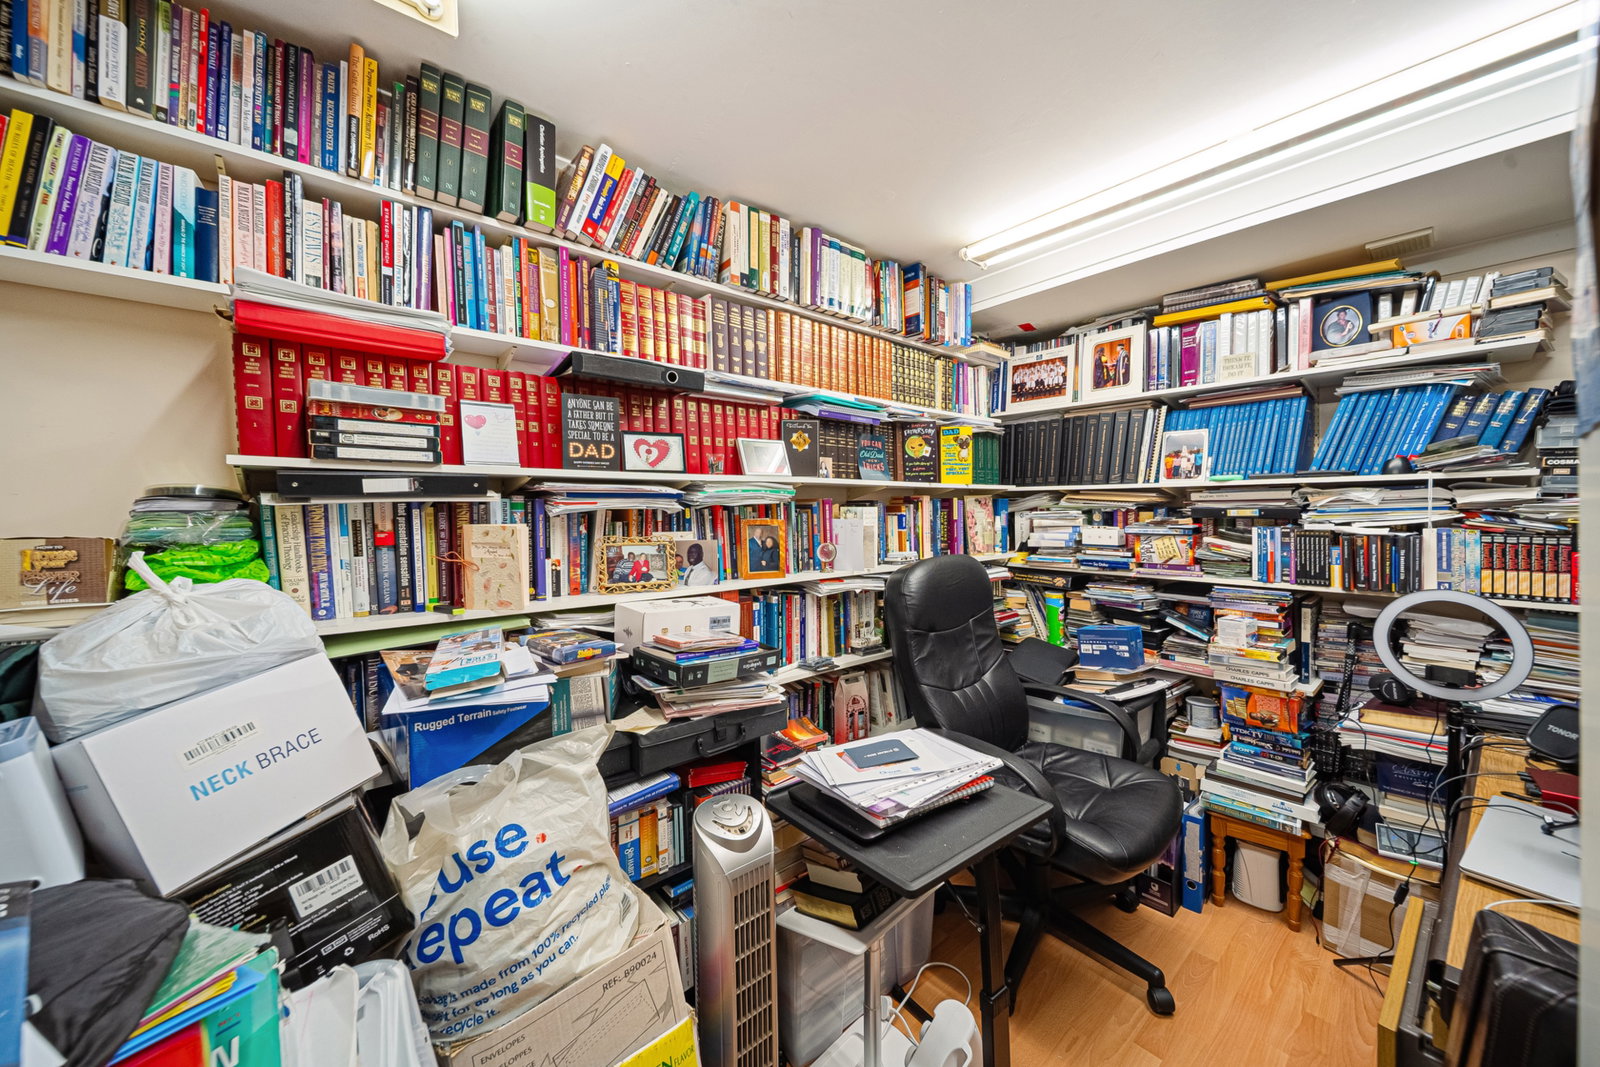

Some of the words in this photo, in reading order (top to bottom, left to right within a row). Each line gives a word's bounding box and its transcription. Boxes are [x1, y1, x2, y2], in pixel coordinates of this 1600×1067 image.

[138, 18, 147, 48] BOOK
[254, 36, 264, 56] PRAISE
[208, 42, 217, 70] KENDALL
[352, 55, 360, 69] The
[110, 60, 120, 84] TRUST
[254, 57, 264, 86] RELEASES
[366, 68, 374, 86] Purpose
[327, 70, 335, 94] PRAYER
[254, 87, 262, 105] FAITH
[351, 88, 359, 114] Church
[326, 100, 335, 128] RICHARD
[14, 121, 24, 132] THE
[366, 112, 374, 140] AUTHORITY
[11, 132, 20, 148] RULES
[35, 131, 43, 142] THE
[326, 128, 334, 151] FOSTER
[10, 149, 18, 158] OF
[32, 143, 41, 158] RULES
[90, 145, 109, 164] MAYA
[4, 159, 15, 180] WEALTH
[30, 160, 38, 168] OF
[118, 154, 136, 175] MAYA
[140, 161, 154, 180] MAYA
[160, 165, 170, 180] MAYA
[27, 169, 36, 184] WORK
[64, 176, 76, 192] Beauty
[84, 164, 104, 196] ANGELOU
[220, 177, 229, 194] MAYA
[114, 176, 134, 206] ANGELOU
[138, 180, 151, 204] ANGELOU
[160, 180, 169, 207] ANGELOU
[238, 186, 250, 203] MAYA
[254, 190, 264, 207] MAYA
[60, 200, 70, 212] Ashes
[220, 194, 230, 218] ANGELOU
[238, 203, 250, 232] ANGELOU
[254, 208, 264, 235] ANGELOU
[304, 230, 322, 264] LEWIS
[567, 398, 592, 409] ANYONE
[592, 400, 606, 410] CAN
[606, 402, 614, 411] BE
[568, 410, 572, 418] A
[573, 410, 594, 420] FATHER
[595, 411, 606, 420] BUT
[608, 412, 614, 420] IT
[567, 419, 586, 430] TAKES
[587, 420, 614, 432] SOMEONE
[567, 430, 592, 440] SPECIAL
[592, 432, 601, 440] TO
[602, 432, 609, 441] BE
[610, 432, 614, 441] A
[860, 439, 872, 448] YOU
[872, 440, 882, 449] CAN
[568, 442, 616, 460] DAD
[860, 450, 872, 458] Old
[872, 450, 884, 458] Dad
[862, 462, 884, 472] TRICKS
[398, 503, 406, 516] that
[264, 522, 273, 537] BARNA
[290, 511, 301, 541] Leadership
[438, 512, 446, 530] LEADERS
[282, 520, 292, 544] Practical
[396, 517, 408, 556] presentation
[294, 542, 304, 574] Handbooks
[310, 538, 328, 572] PREACHING
[439, 540, 448, 557] LOYALTY
[282, 546, 294, 571] Theology
[381, 548, 390, 572] RUDOLPH
[400, 556, 409, 586] sensation
[24, 576, 78, 602] Life
[382, 580, 390, 604] GIULIANI
[1225, 666, 1250, 676] CHARLES
[1252, 670, 1270, 678] CAPPS
[1230, 675, 1255, 684] CHARLES
[1256, 678, 1275, 687] CAPPS
[414, 715, 456, 732] Rugged
[457, 708, 492, 724] Terrain
[1234, 726, 1252, 738] TDK
[1252, 730, 1264, 739] TV
[1548, 724, 1579, 740] TONOR
[1232, 746, 1256, 755] SONY
[188, 758, 254, 802] NECK
[256, 726, 322, 770] BRACE
[624, 847, 634, 858] 8th
[368, 924, 390, 942] RoHS
[460, 976, 497, 998] made
[498, 959, 530, 980] from
[532, 930, 560, 960] 100%
[561, 895, 598, 934] recycled
[451, 1005, 471, 1018] for
[490, 982, 520, 1001] long
[520, 972, 535, 985] as
[536, 952, 557, 976] you
[558, 934, 579, 954] can.
[602, 974, 622, 992] REF:
[624, 951, 657, 978] B90024
[439, 1016, 484, 1036] recycle
[486, 1008, 500, 1024] it.
[480, 1034, 526, 1065] ENVELOPES
[674, 1045, 694, 1064] FLAVOR
